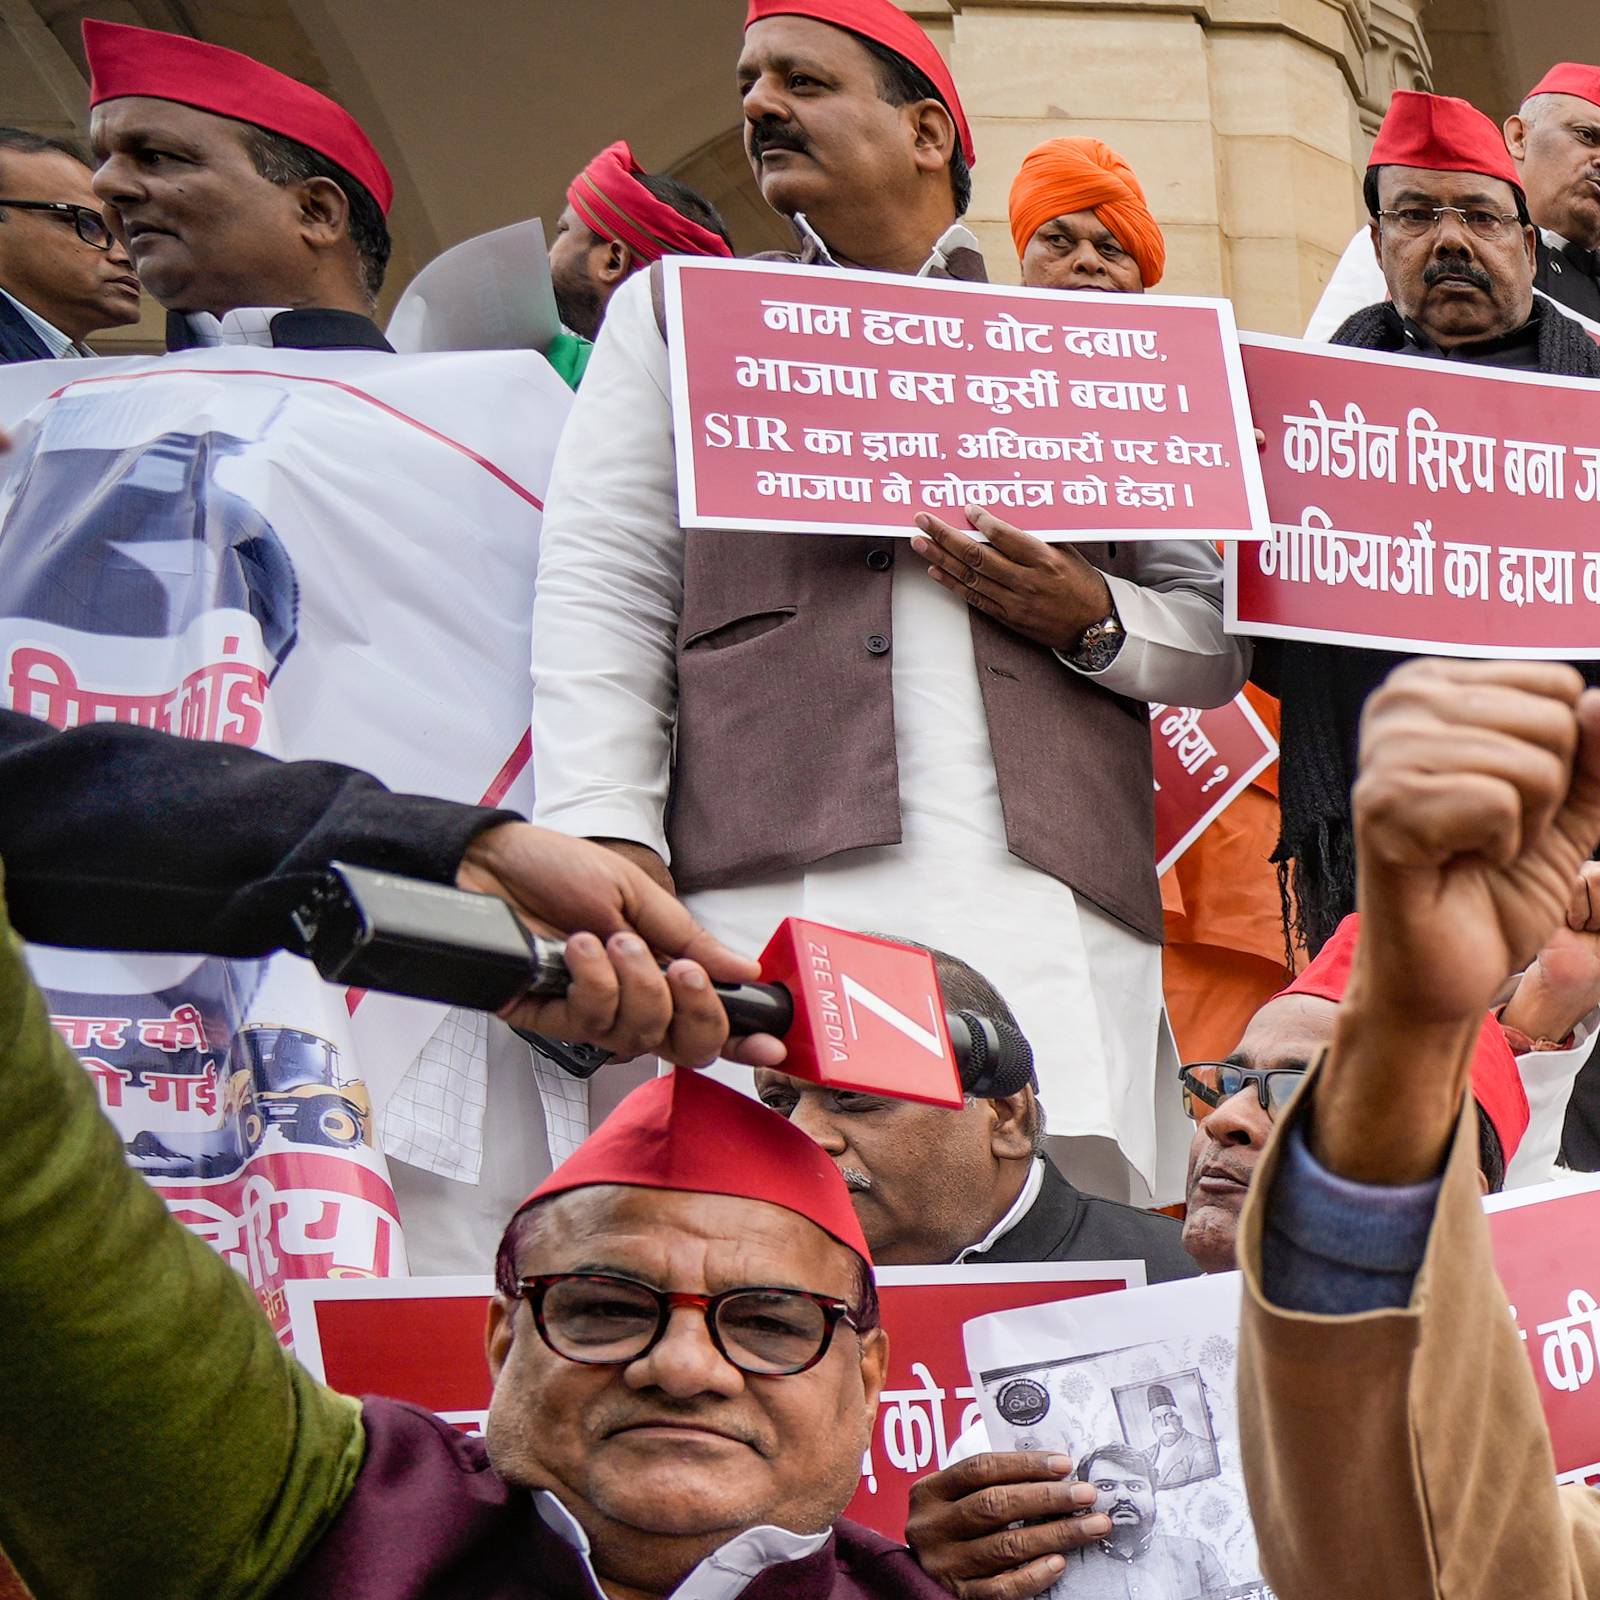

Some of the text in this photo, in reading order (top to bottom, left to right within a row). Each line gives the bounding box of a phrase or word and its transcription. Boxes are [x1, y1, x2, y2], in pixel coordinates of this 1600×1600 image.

[761, 300, 1167, 361] नाम हटाए, वोट दबाए,
[736, 356, 878, 399] भाजपा
[888, 370, 956, 404] बस
[966, 369, 1059, 414] कुर्सी
[705, 413, 794, 451] SIR
[803, 428, 853, 455] का
[861, 432, 946, 461] ड्रामा,
[957, 427, 1103, 462] अधिकारों
[1111, 440, 1158, 464] पर
[1283, 400, 1399, 482] कोडीन
[1407, 408, 1496, 493] सिरप
[1504, 440, 1566, 499] बना
[757, 471, 873, 502] भाजपा
[881, 472, 912, 504] ने
[1062, 475, 1107, 505] को
[1444, 542, 1491, 600] का
[808, 942, 849, 1063] ZEE MEDIA
